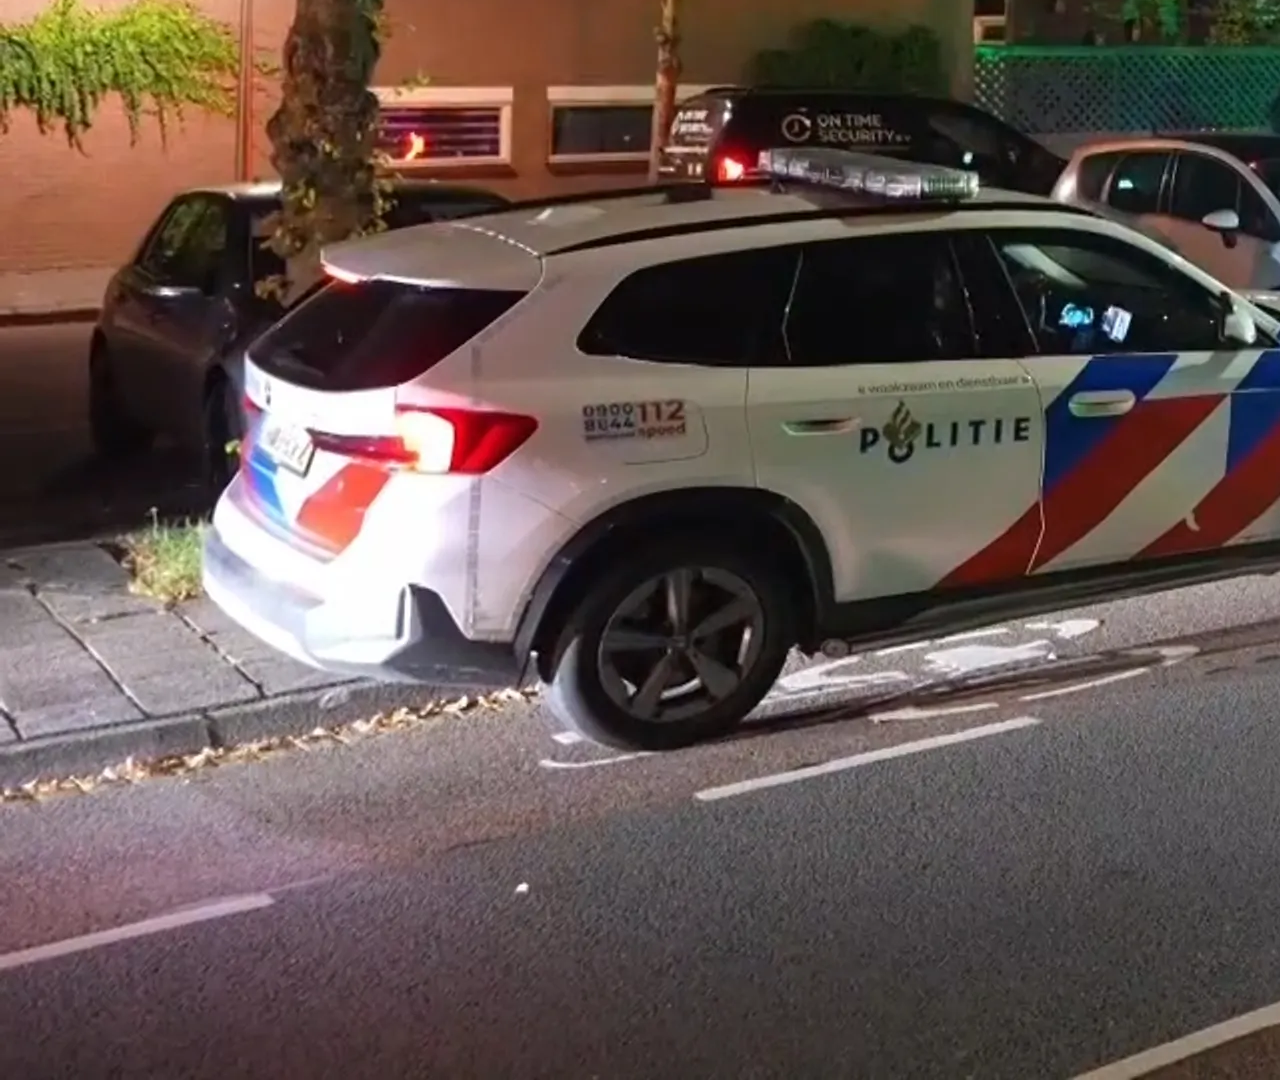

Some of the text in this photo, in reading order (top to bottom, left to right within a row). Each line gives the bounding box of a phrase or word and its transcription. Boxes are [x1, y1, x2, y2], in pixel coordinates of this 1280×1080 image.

[816, 113, 881, 127] ON TIME
[818, 128, 895, 143] SECURITY
[636, 399, 685, 423] 112
[859, 410, 1031, 464] POLITIE
